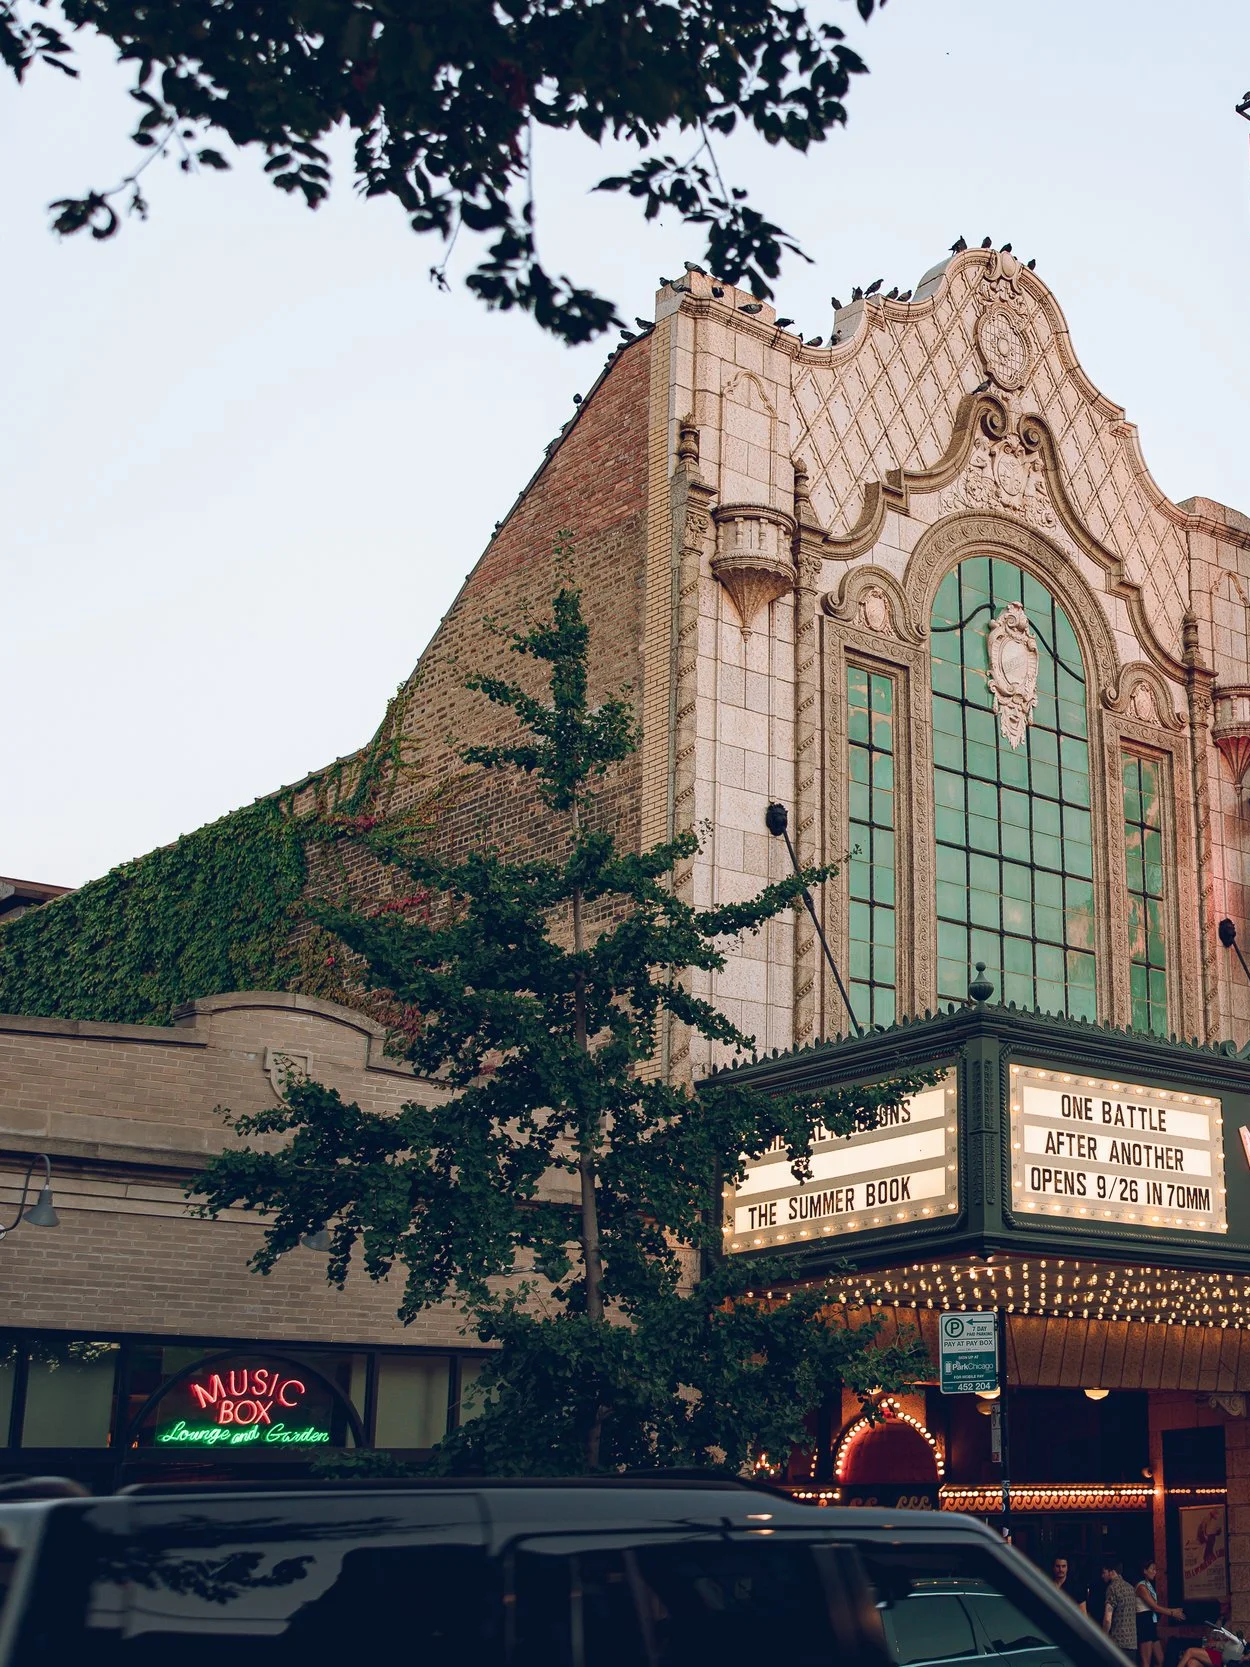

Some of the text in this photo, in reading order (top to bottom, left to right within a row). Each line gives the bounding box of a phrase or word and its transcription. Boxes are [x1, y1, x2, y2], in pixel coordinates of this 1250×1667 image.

[1061, 1094, 1167, 1132] ONE BATTLE
[1045, 1131, 1184, 1171] AFTER ANOTHER
[748, 1175, 911, 1229] THE SUMMER BOOK
[1030, 1167, 1211, 1211] OPENS 9/26 IN 70MM
[952, 1362, 994, 1371] ParkChicago
[192, 1369, 306, 1408] MUSIC
[957, 1383, 974, 1391] 452
[975, 1382, 991, 1390] 204
[218, 1399, 274, 1425] BOX
[161, 1421, 330, 1444] Lounge and Garden
